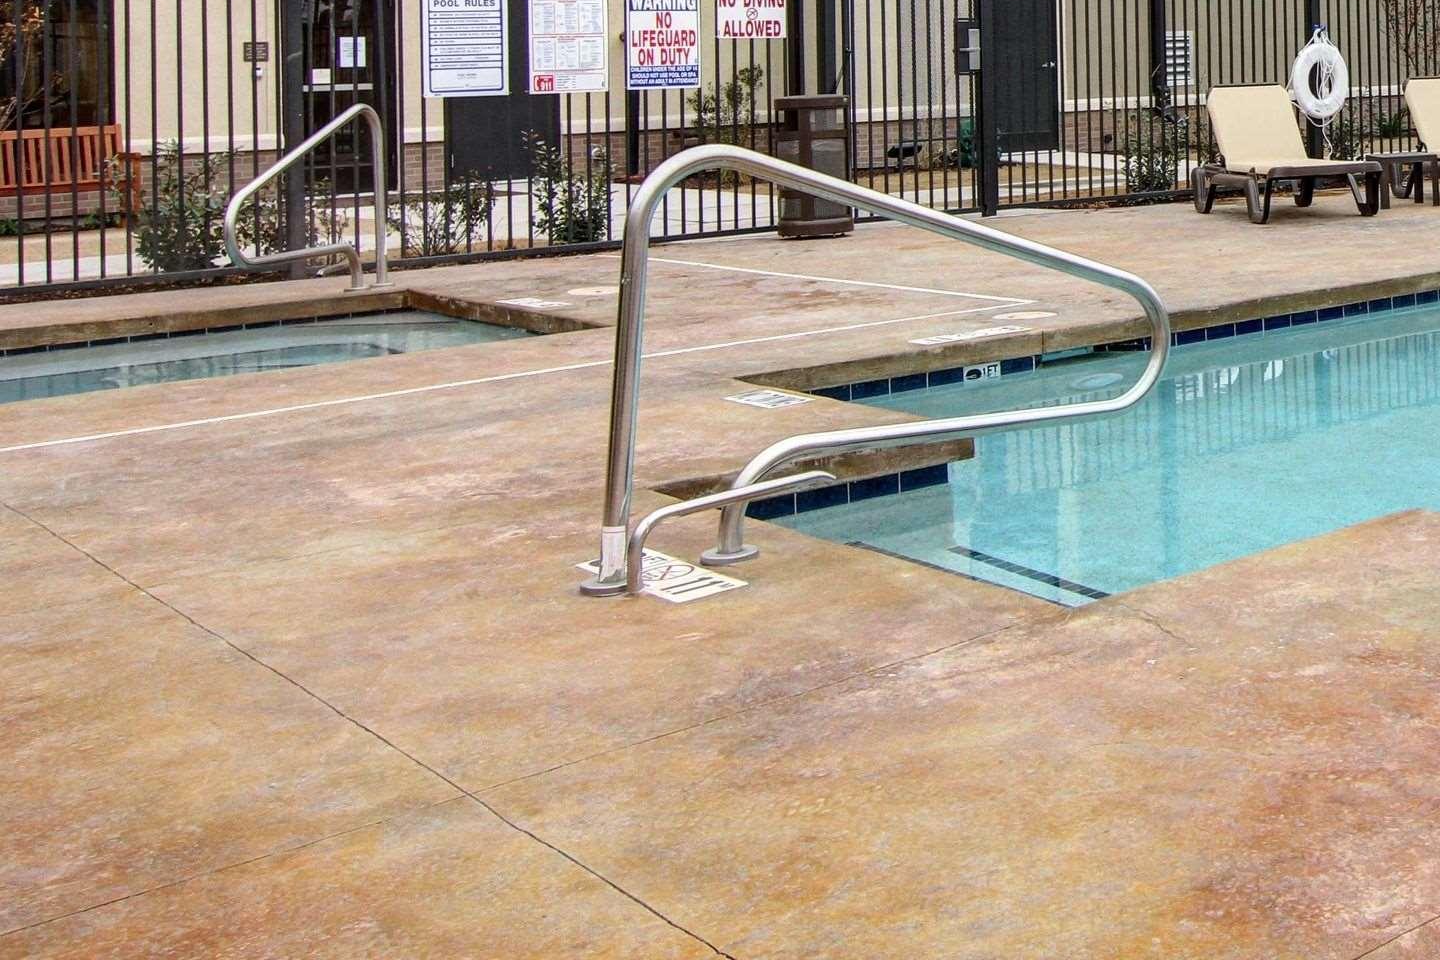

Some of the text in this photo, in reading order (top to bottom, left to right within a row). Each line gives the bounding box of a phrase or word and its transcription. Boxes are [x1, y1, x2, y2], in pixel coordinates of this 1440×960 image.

[433, 0, 496, 7] POOL RULES
[656, 12, 672, 29] NO
[723, 20, 781, 37] ALLOWED
[632, 30, 696, 48] LIFEGUARD
[638, 48, 690, 65] ON DUTY
